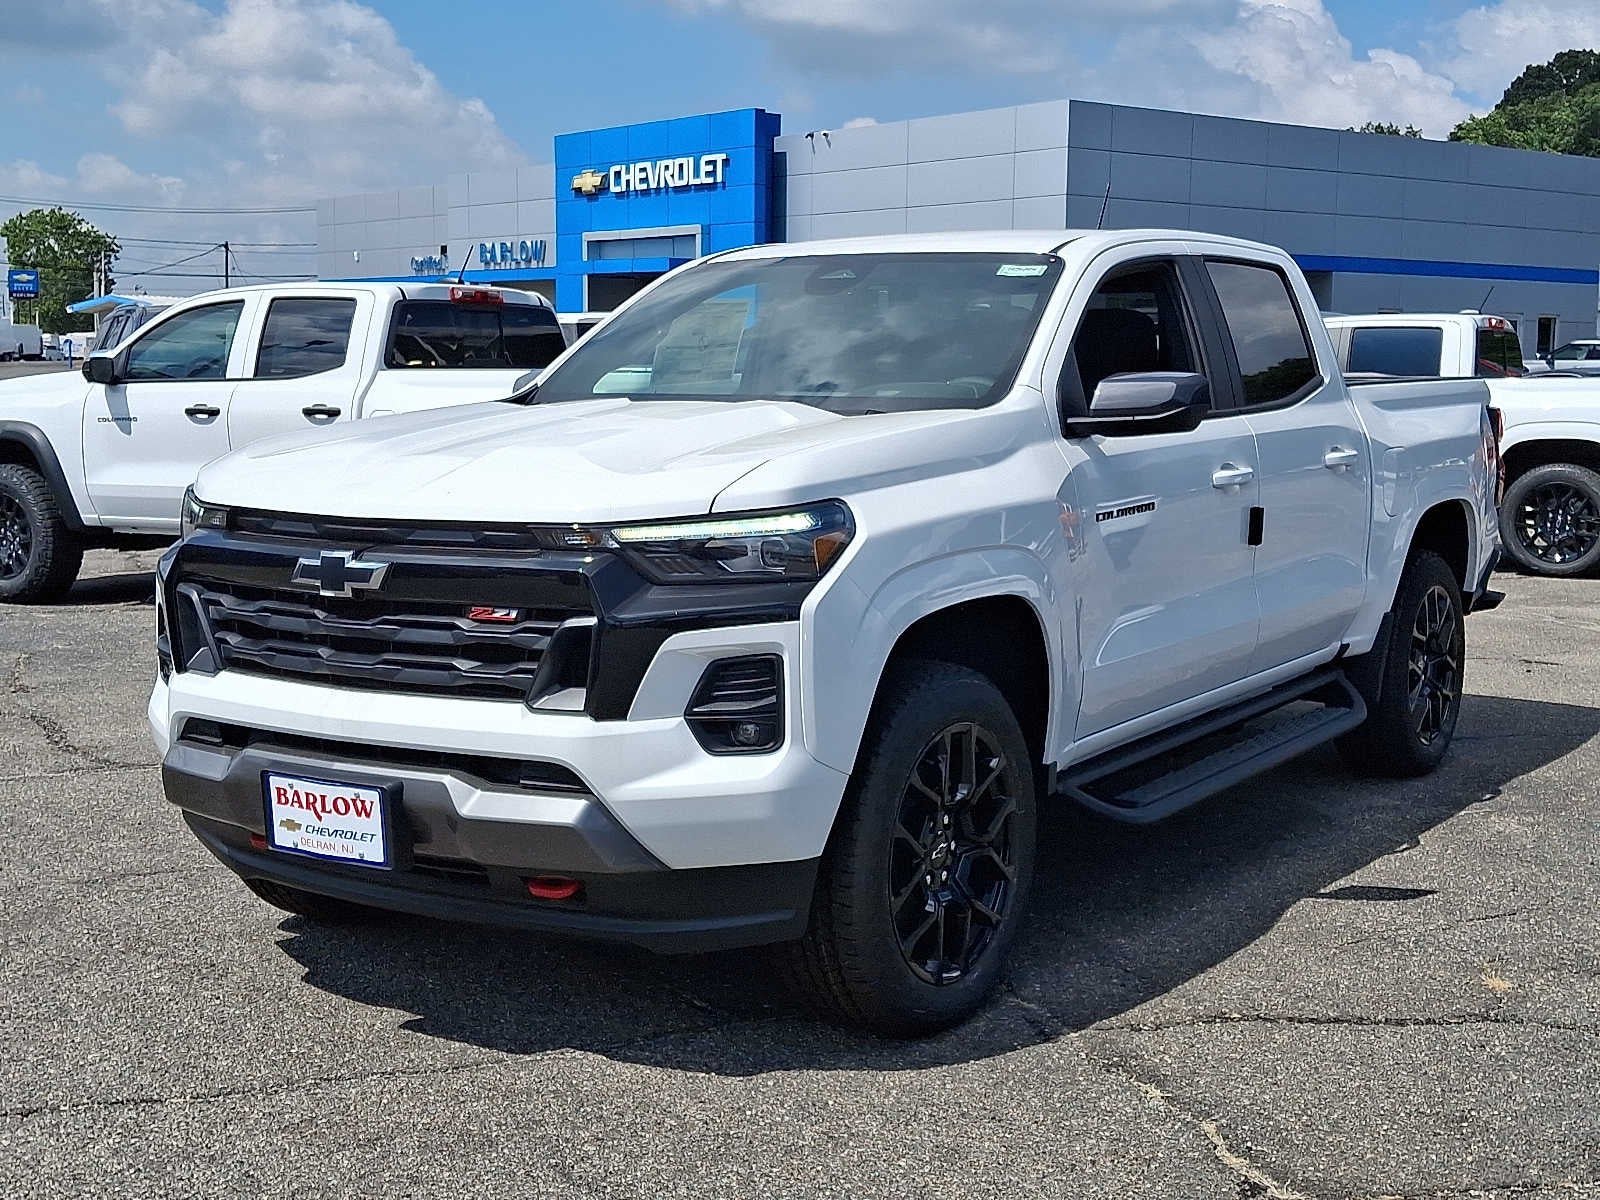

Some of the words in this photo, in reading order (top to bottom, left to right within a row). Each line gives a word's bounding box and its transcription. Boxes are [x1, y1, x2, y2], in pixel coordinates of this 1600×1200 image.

[609, 153, 727, 193] CHEVROLET
[479, 240, 547, 264] BARLOW
[1095, 501, 1156, 523] COLORADO
[468, 606, 519, 621] Z71
[275, 786, 375, 822] BARLOW
[305, 824, 377, 843] CHEVROLET
[300, 837, 339, 854] DELRAN,
[341, 844, 354, 854] NJ
